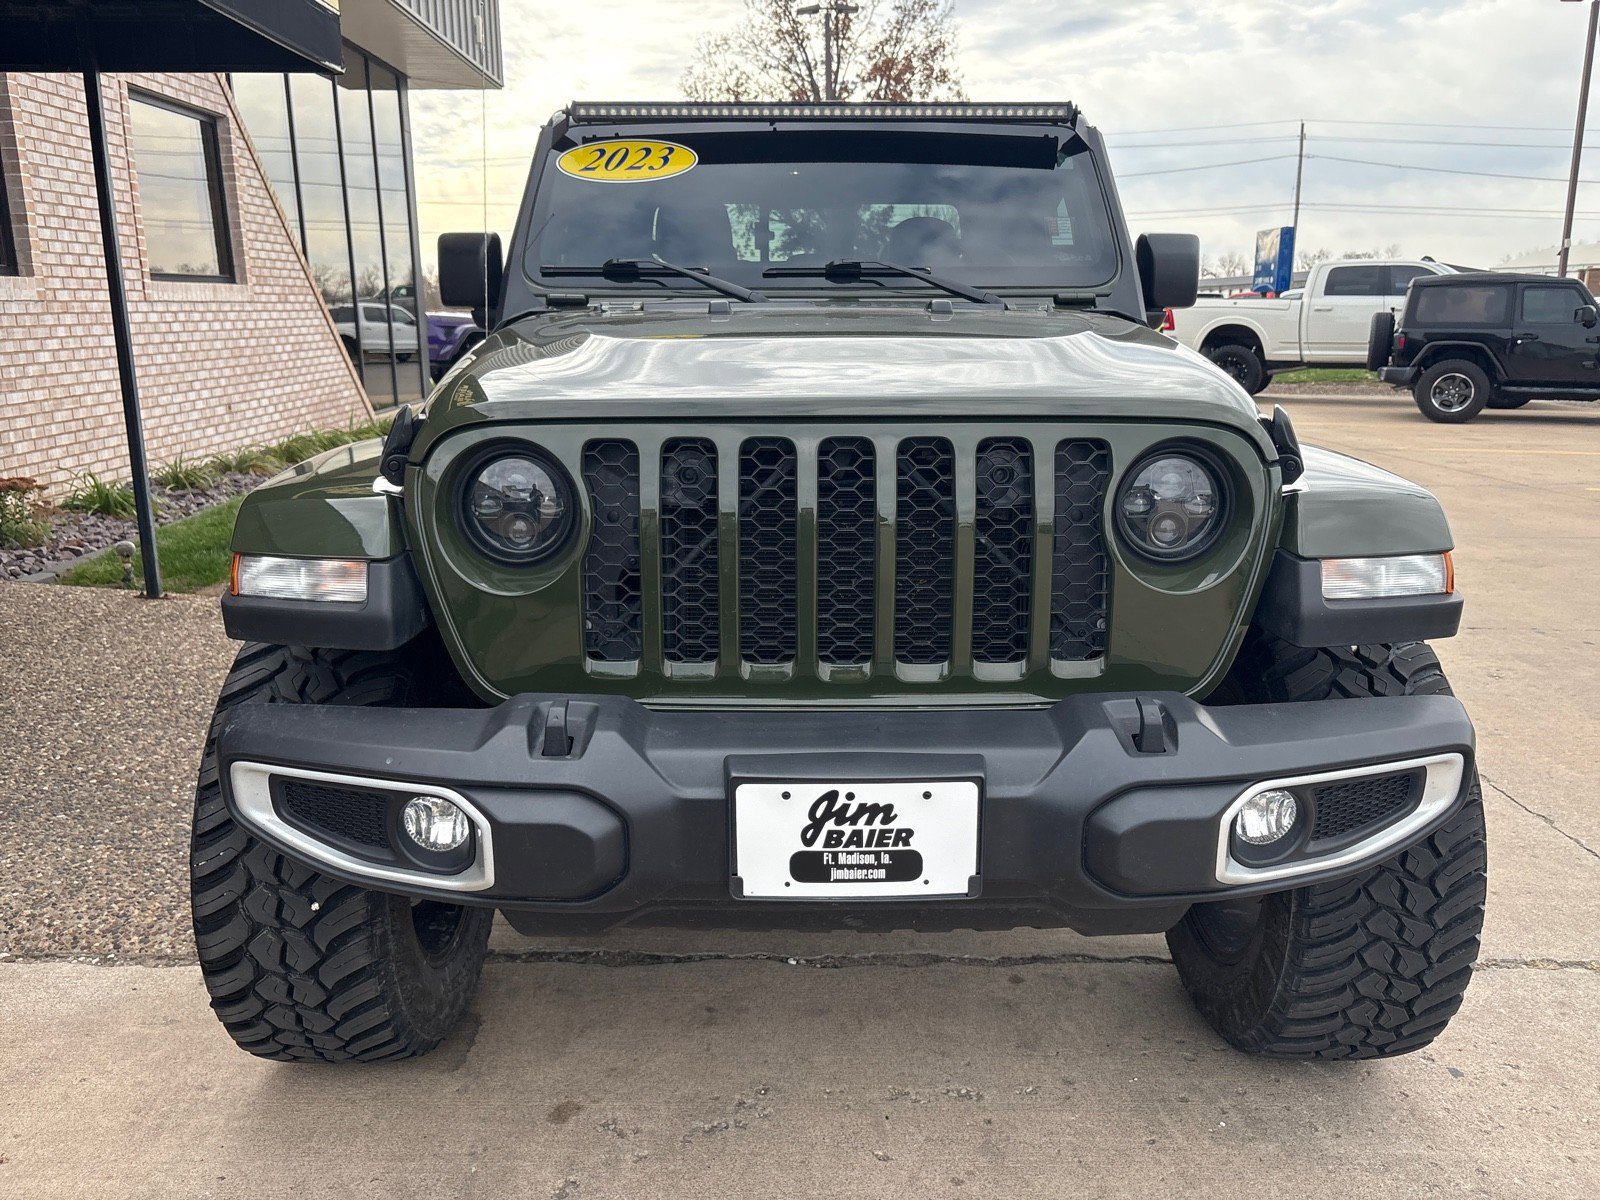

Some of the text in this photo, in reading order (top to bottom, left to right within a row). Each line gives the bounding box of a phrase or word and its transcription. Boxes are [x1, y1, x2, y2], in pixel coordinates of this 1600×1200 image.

[578, 147, 675, 172] 2023
[801, 789, 898, 848] Jim
[823, 828, 915, 848] BAIER
[824, 853, 835, 865] Ft.
[838, 853, 878, 866] Madison,
[831, 868, 886, 882] jimbaier.com
